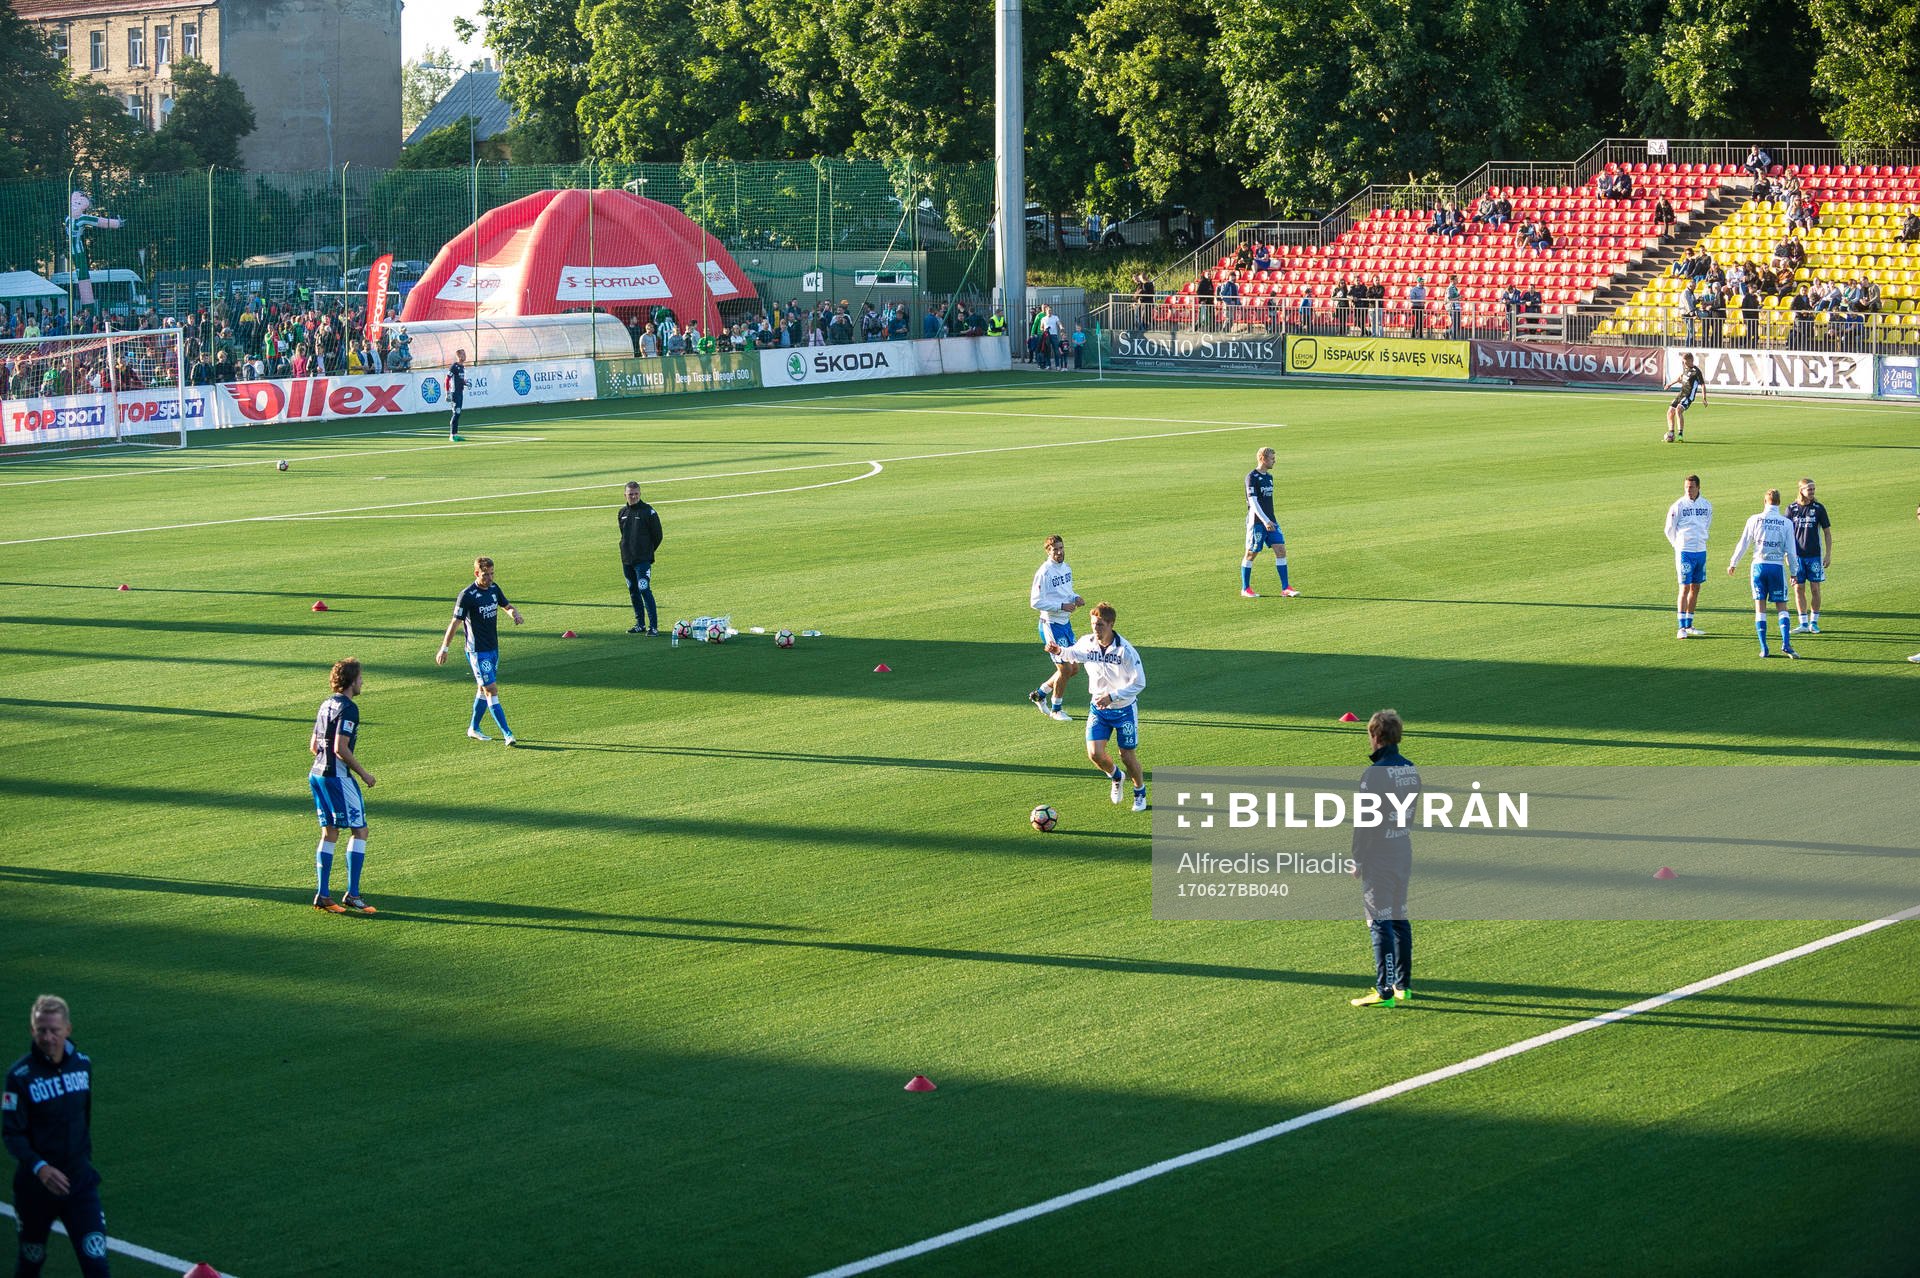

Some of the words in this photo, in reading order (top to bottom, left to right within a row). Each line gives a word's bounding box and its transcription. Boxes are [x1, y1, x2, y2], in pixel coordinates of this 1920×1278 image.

[584, 275, 660, 288] SPORTLAND
[1118, 331, 1194, 358] SKONIO
[1200, 333, 1274, 361] SLĖNIS
[814, 351, 889, 374] ŠKODA
[1323, 347, 1375, 362] IŠSPAUSK
[1379, 348, 1389, 362] IŠ
[1392, 351, 1426, 367] SAVĘS
[1431, 353, 1464, 369] VISKĄ
[1495, 350, 1598, 373] VILNIAUS
[1601, 355, 1659, 376] ALUS
[474, 377, 488, 388] AG
[534, 370, 563, 382] GRIFS
[564, 369, 578, 381] AG
[626, 372, 665, 387] SATIMED
[675, 372, 691, 386] Deep
[692, 371, 713, 383] Tissue
[12, 406, 104, 432] TOPsport
[118, 399, 203, 424] TOPsprt
